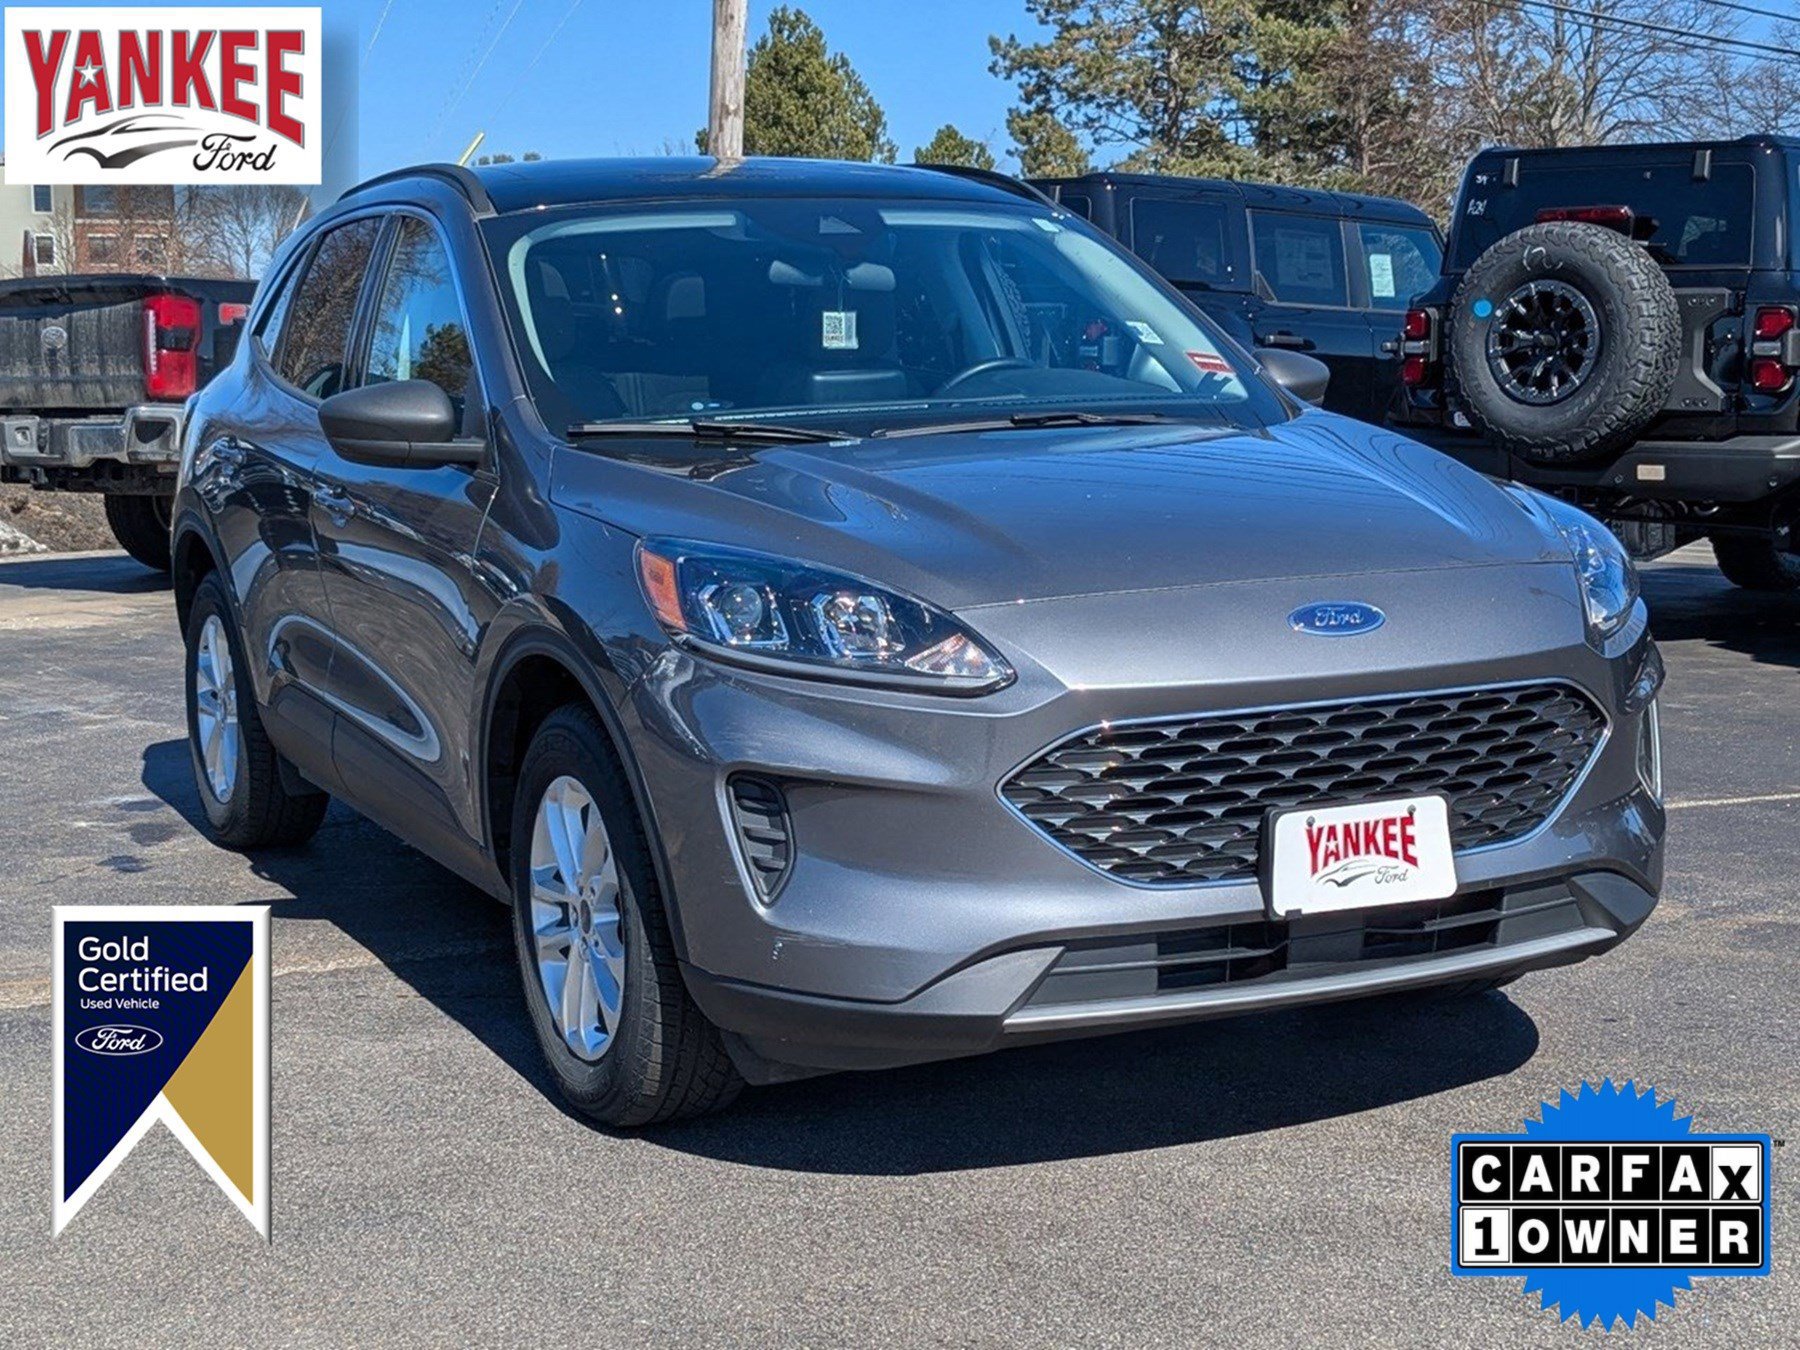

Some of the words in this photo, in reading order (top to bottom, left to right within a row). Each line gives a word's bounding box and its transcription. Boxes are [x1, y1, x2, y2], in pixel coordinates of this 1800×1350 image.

[1315, 606, 1364, 627] Ford
[1305, 815, 1418, 878] YANKEE
[1374, 865, 1409, 885] Ford
